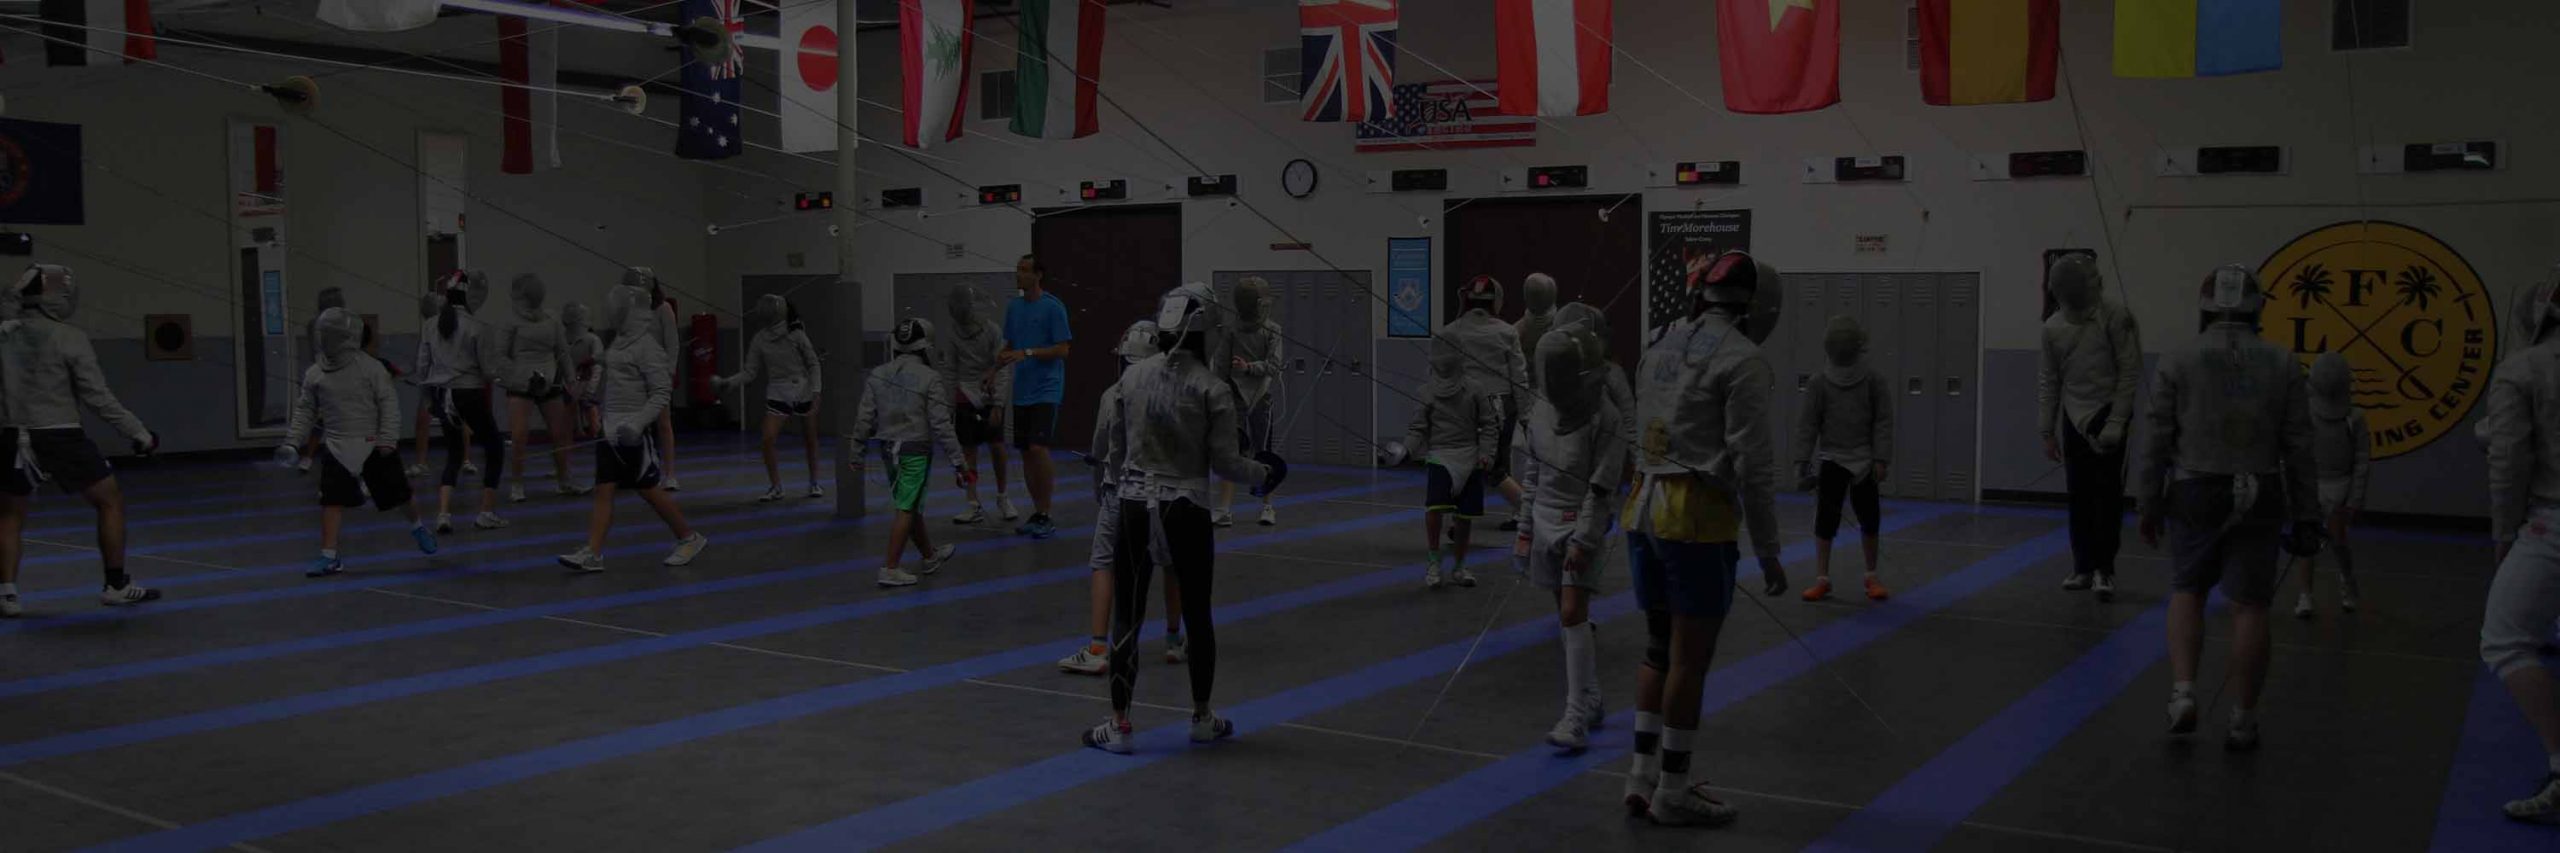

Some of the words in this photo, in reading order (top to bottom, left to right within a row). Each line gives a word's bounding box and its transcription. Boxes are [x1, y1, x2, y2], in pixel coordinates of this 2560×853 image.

[1420, 98, 1473, 122] USA
[1681, 221, 1740, 233] Morehouse
[2341, 269, 2388, 307] F
[2286, 317, 2328, 353] L
[2401, 318, 2443, 358] C
[2368, 419, 2424, 447] ING
[2428, 328, 2484, 420] CENTER
